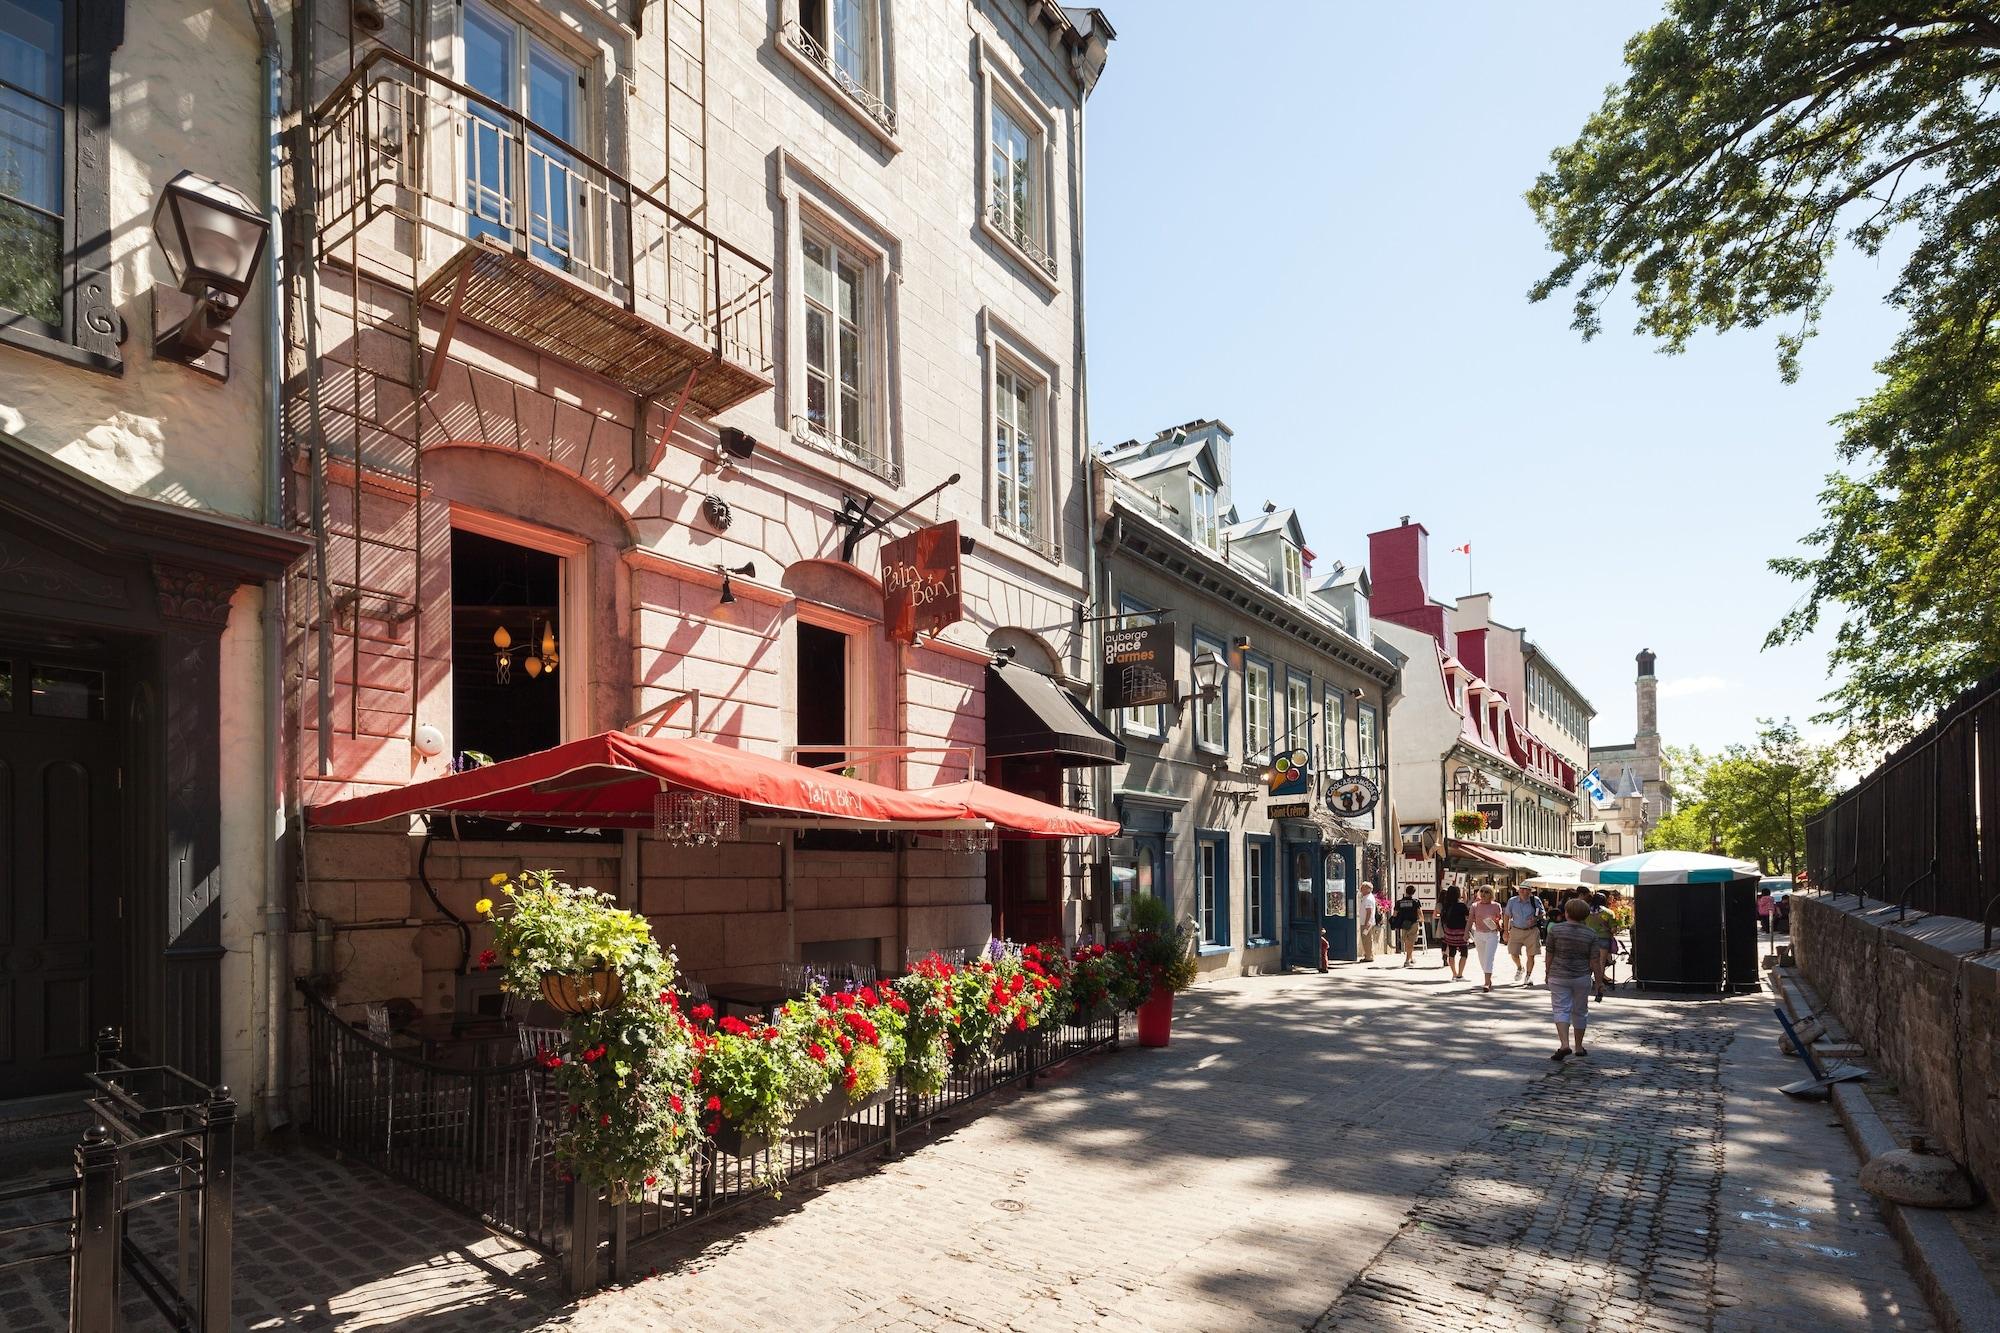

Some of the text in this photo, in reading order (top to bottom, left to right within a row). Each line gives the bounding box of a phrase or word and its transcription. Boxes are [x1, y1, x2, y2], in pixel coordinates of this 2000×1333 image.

[882, 561, 923, 600] Pain
[1105, 630, 1148, 642] auberge
[1105, 641, 1141, 656] place
[1105, 650, 1154, 664] d'armes
